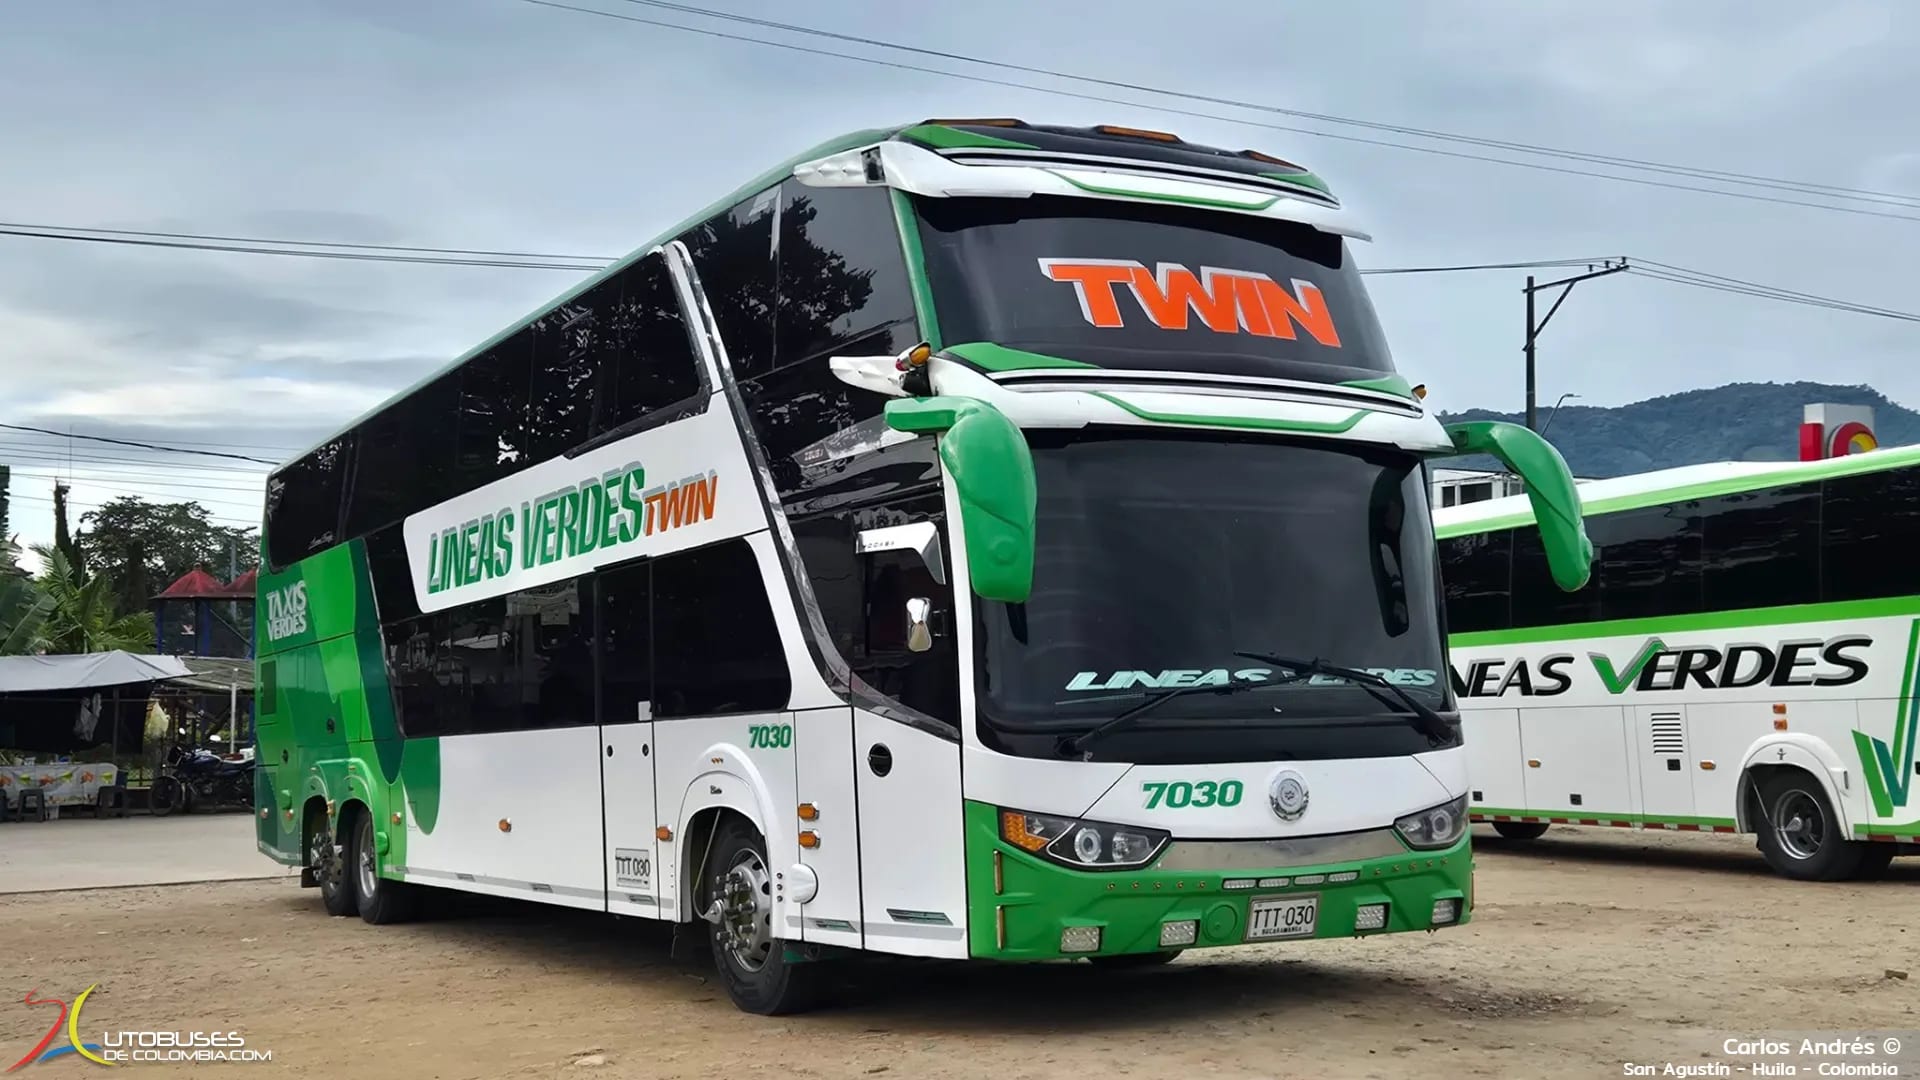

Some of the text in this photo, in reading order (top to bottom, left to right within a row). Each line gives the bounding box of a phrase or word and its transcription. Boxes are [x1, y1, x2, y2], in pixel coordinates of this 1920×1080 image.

[1037, 257, 1342, 348] TWIN
[427, 460, 719, 594] LINEAS VERDES TWIN
[266, 580, 307, 620] TAXIS
[266, 612, 307, 642] VERDES
[1282, 668, 1438, 687] EDES
[1586, 634, 1874, 695] VERDES
[748, 723, 793, 749] 7030
[1141, 779, 1244, 810] 7030
